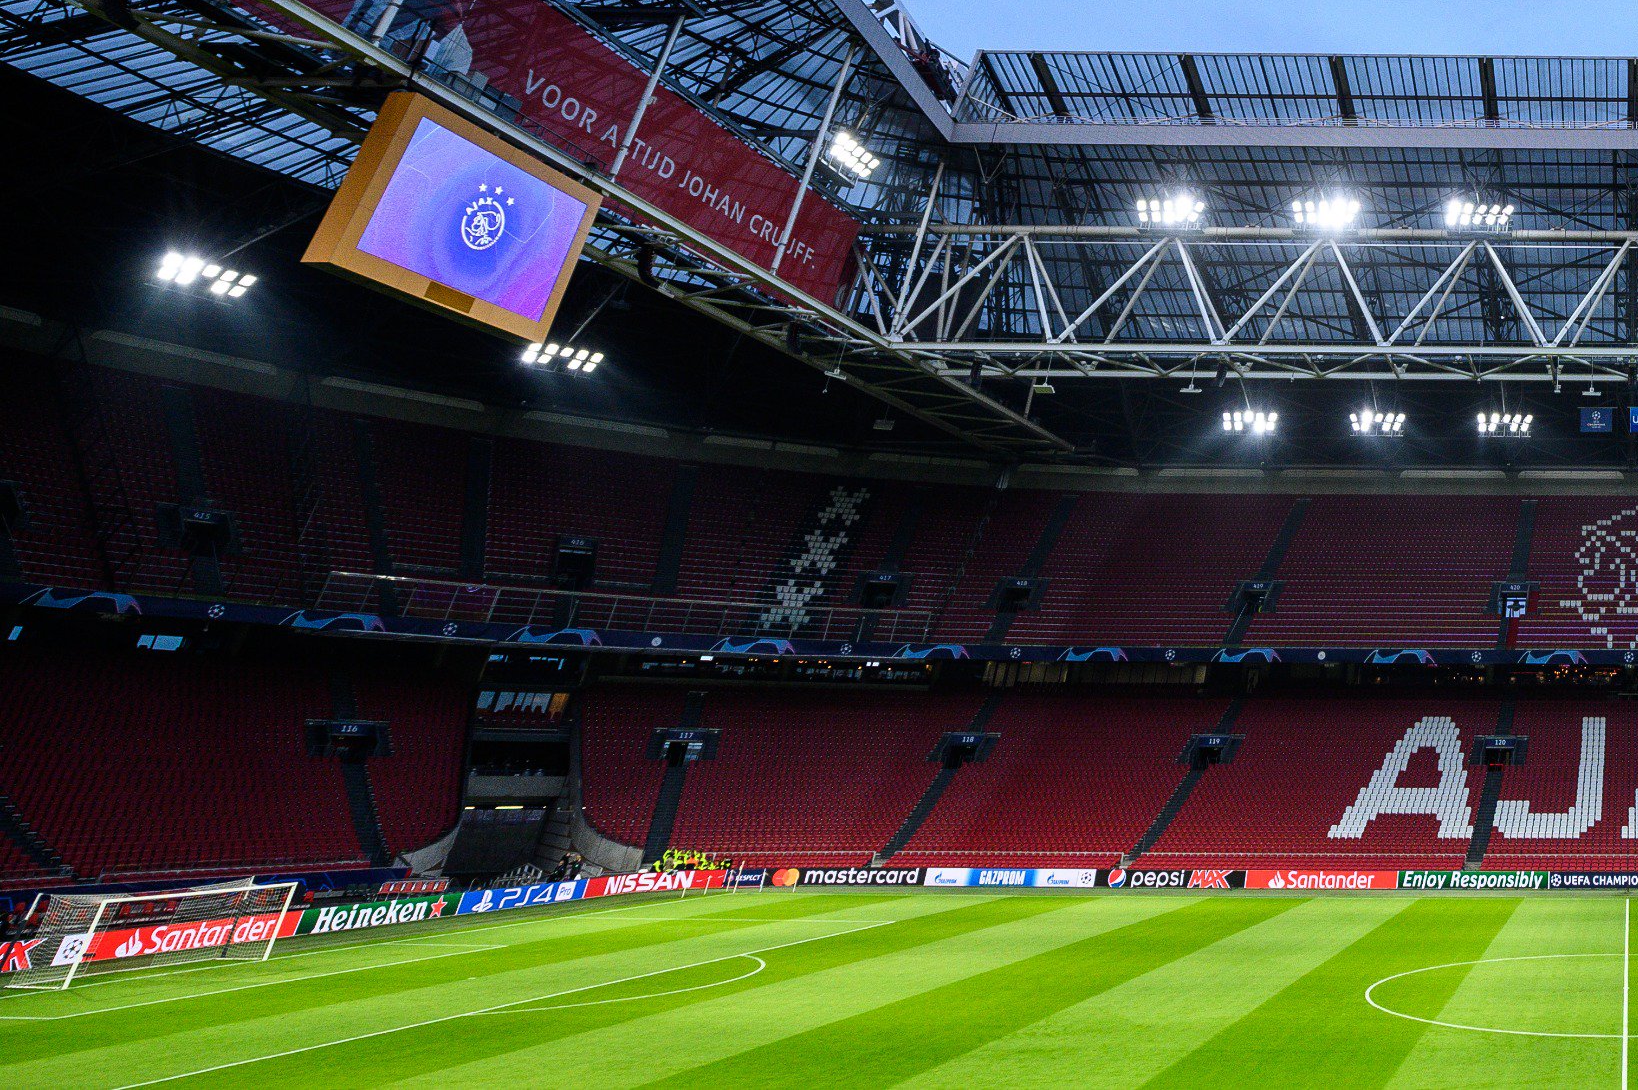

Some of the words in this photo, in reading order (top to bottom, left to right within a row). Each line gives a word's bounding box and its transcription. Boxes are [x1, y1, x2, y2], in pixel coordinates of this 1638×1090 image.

[524, 69, 598, 135] VOOR
[600, 124, 675, 178] ATIJD
[678, 170, 747, 225] JOHAN
[749, 214, 815, 269] CRUJFF.
[341, 725, 358, 733] 116
[603, 870, 697, 896] NISSAN
[803, 867, 920, 885] mastercard
[978, 870, 1026, 885] GAZPROM
[1130, 870, 1184, 888] pepsi
[1187, 870, 1235, 888] MAX
[1287, 870, 1375, 889] Santander
[1402, 871, 1447, 889] Enjoy
[1450, 871, 1543, 889] Responsibly
[1563, 875, 1590, 885] UEFA
[499, 884, 554, 909] PS4
[559, 886, 572, 897] Pro
[312, 900, 428, 934] Heineken
[144, 916, 277, 953] Santander
